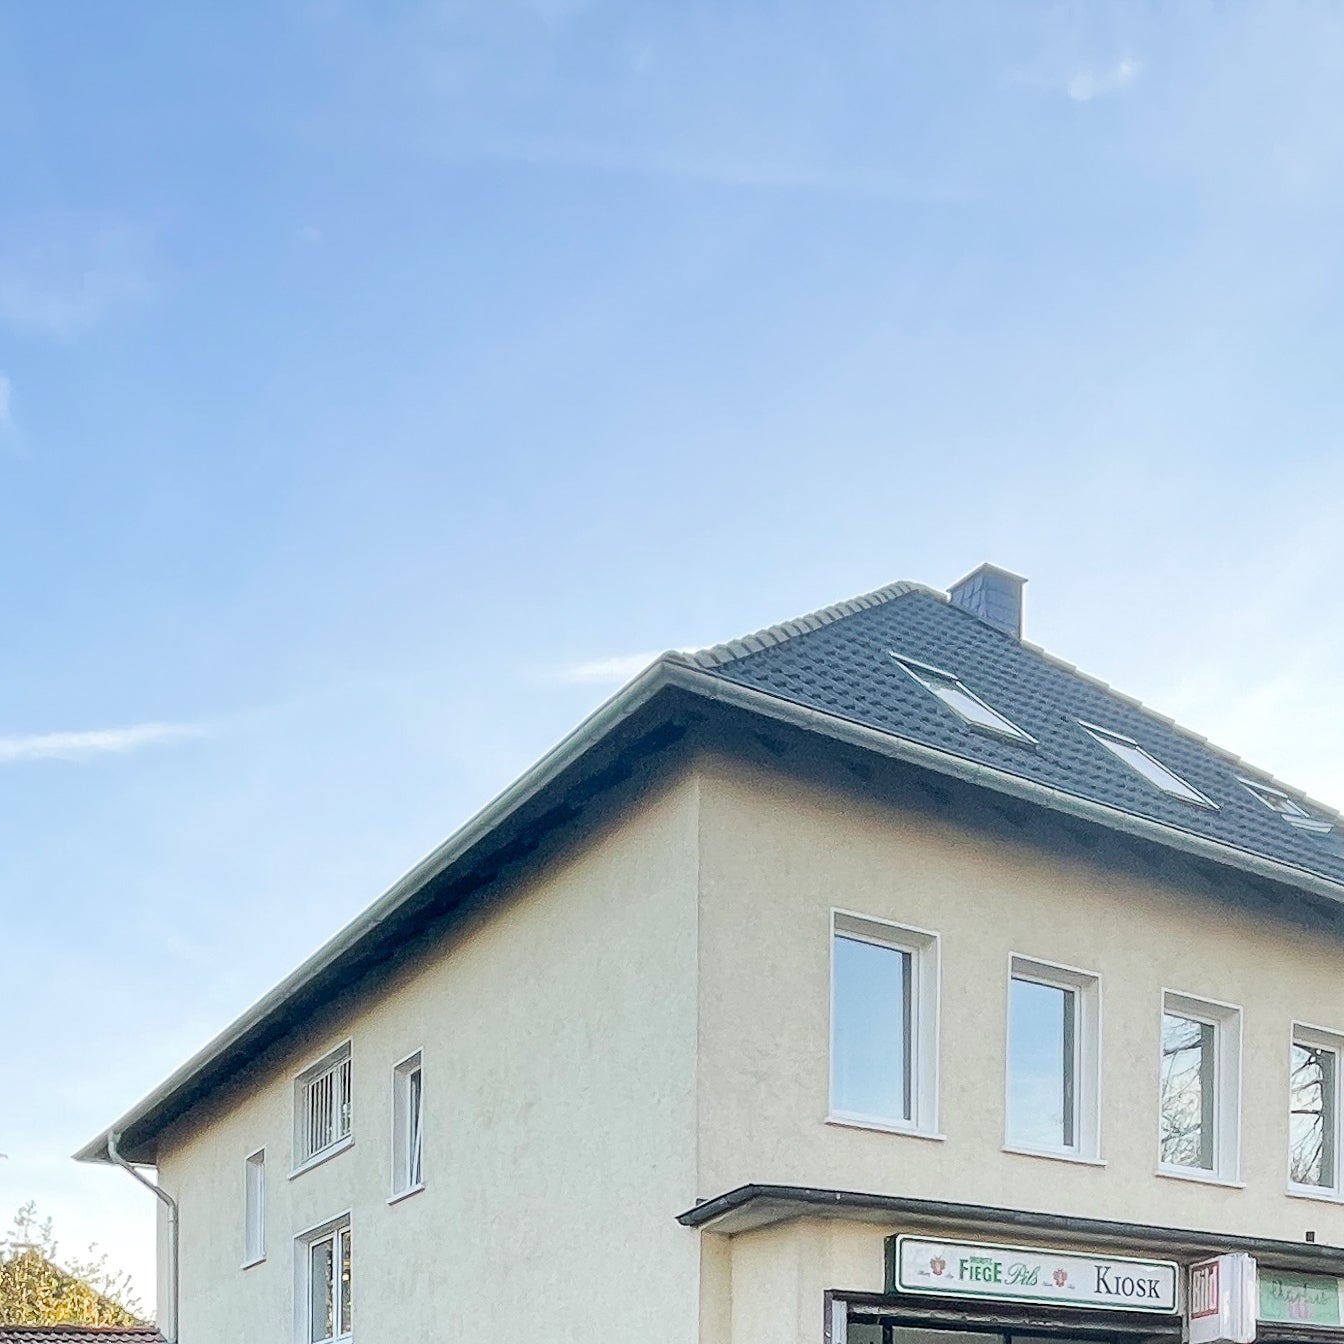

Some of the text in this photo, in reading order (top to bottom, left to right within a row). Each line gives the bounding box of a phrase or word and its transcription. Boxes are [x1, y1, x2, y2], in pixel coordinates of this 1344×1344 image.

[959, 1259, 1160, 1299] FIEGE Pils KIOSK
